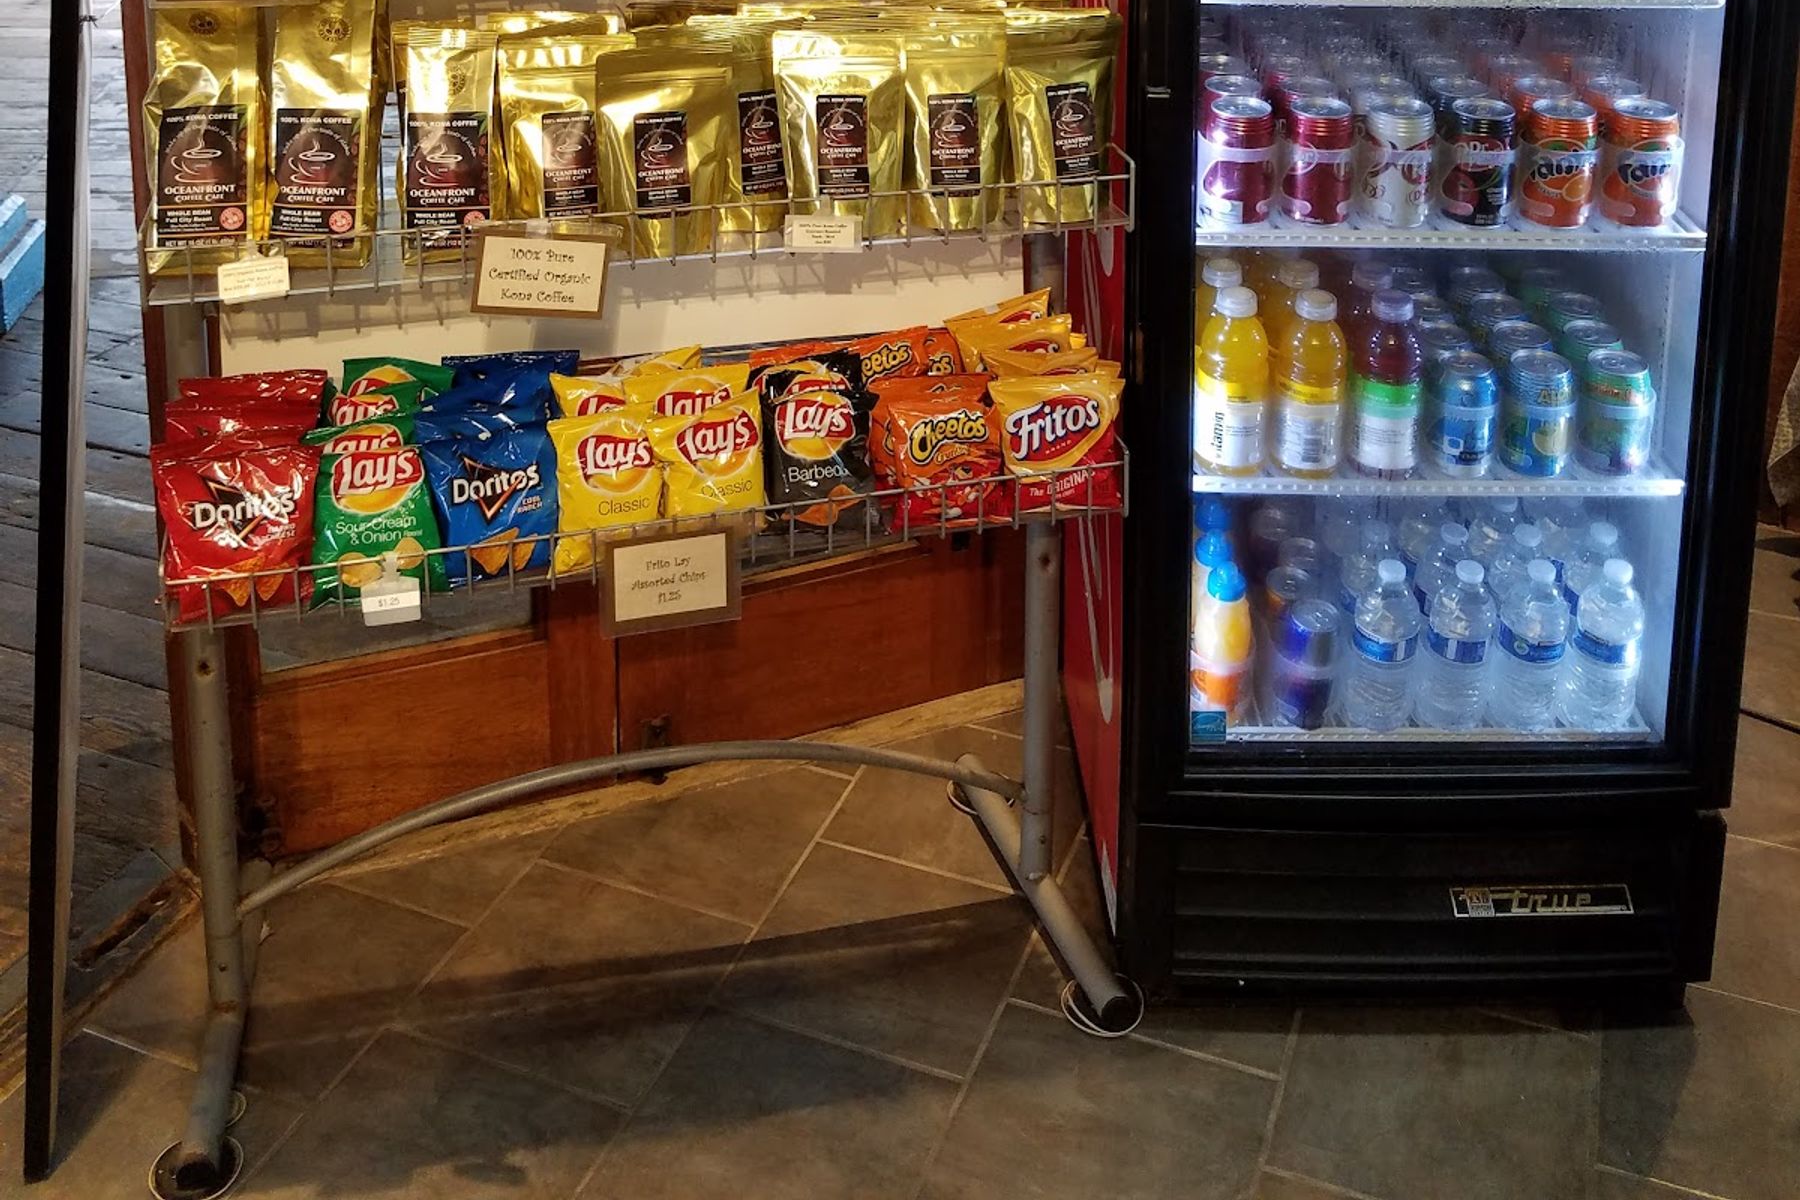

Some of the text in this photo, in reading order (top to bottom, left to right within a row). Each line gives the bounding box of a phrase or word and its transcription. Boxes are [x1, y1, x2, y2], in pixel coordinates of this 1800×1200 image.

[164, 184, 236, 195] OCEANFRONT
[280, 186, 346, 196] OCEANFRONT
[410, 187, 476, 198] OCEANFRONT
[510, 248, 575, 263] 100% Pure
[488, 267, 591, 286] Certified Organic
[500, 288, 574, 303] Kona Coffee
[861, 345, 910, 381] eetos
[783, 402, 850, 439] Lay's
[1005, 400, 1099, 459] Fritos
[685, 416, 749, 462] Lay's
[910, 412, 986, 462] Cheetos
[586, 437, 651, 475] Lay's
[339, 449, 418, 495] Lay's
[453, 464, 540, 503] Doritos
[701, 478, 753, 498] Classic
[194, 493, 295, 528] Doritos
[598, 497, 650, 516] Classic
[335, 514, 416, 535] Sour Cream
[350, 529, 401, 545] & Onion
[646, 557, 691, 571] Frito Lay
[631, 571, 706, 590] Assorted Chips
